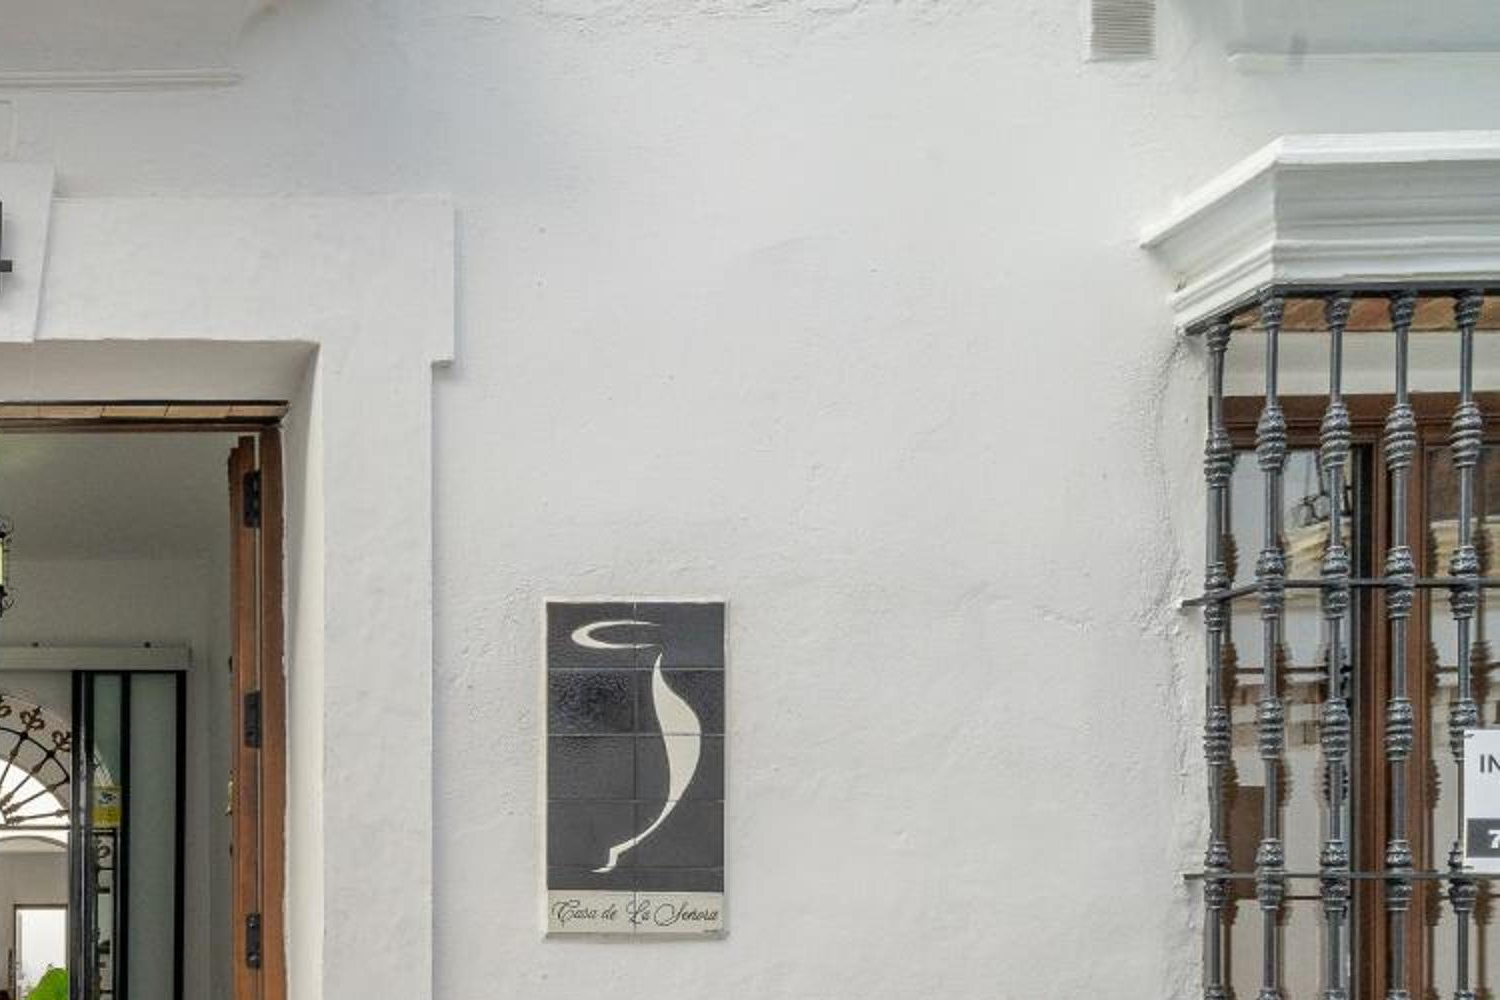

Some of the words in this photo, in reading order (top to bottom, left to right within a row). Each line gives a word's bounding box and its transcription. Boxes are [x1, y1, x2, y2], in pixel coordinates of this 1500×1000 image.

[551, 899, 596, 927] Casa
[601, 903, 618, 921] de
[626, 900, 649, 924] La
